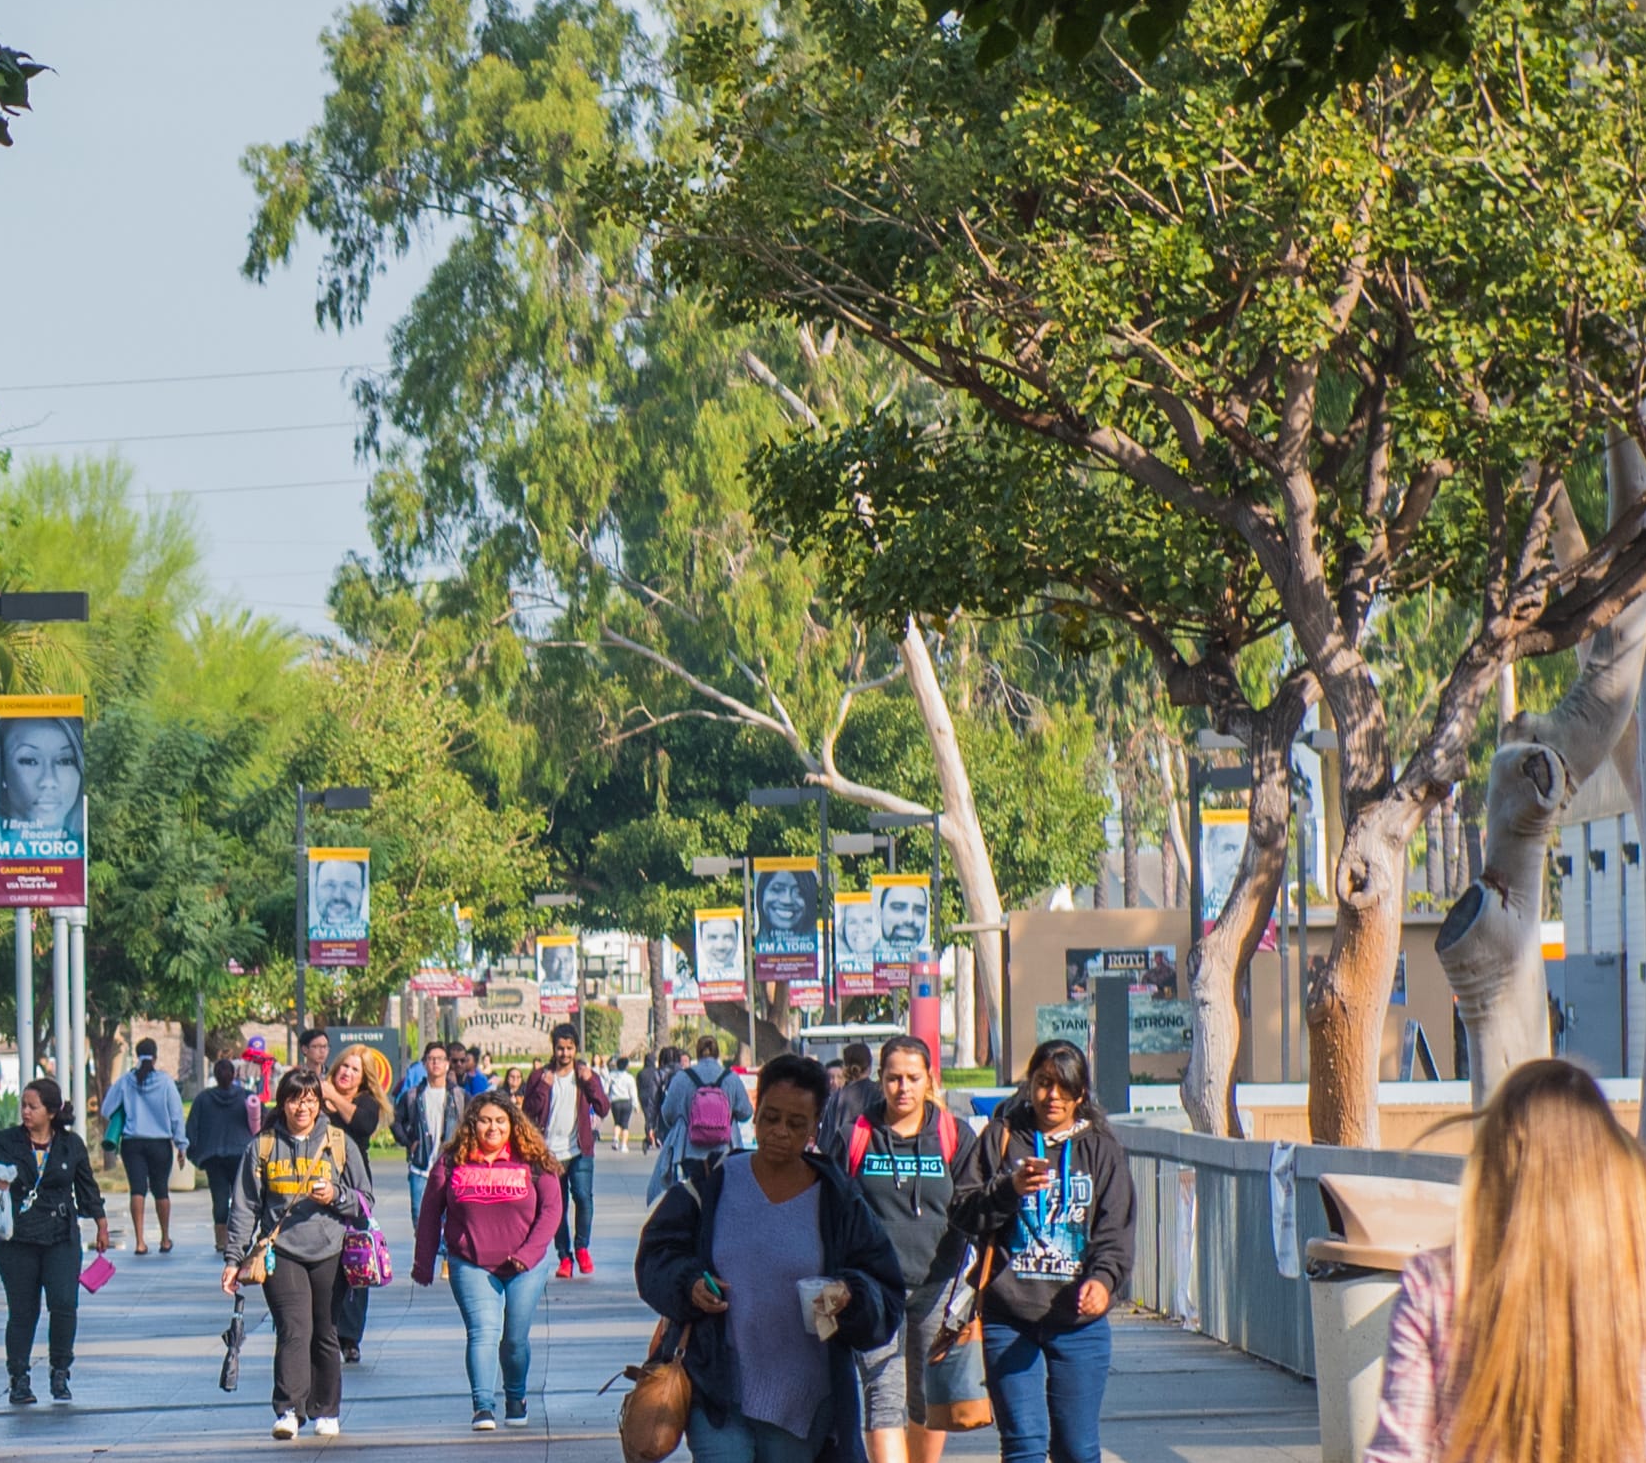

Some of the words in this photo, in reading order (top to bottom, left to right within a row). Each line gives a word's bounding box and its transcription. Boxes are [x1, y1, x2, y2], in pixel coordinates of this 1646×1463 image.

[13, 841, 27, 855] A
[29, 840, 79, 855] TORO
[1108, 953, 1146, 969] ROTC
[1052, 1016, 1089, 1032] STAN
[340, 1032, 384, 1042] DIRECTORY
[1011, 1255, 1037, 1272] SIX
